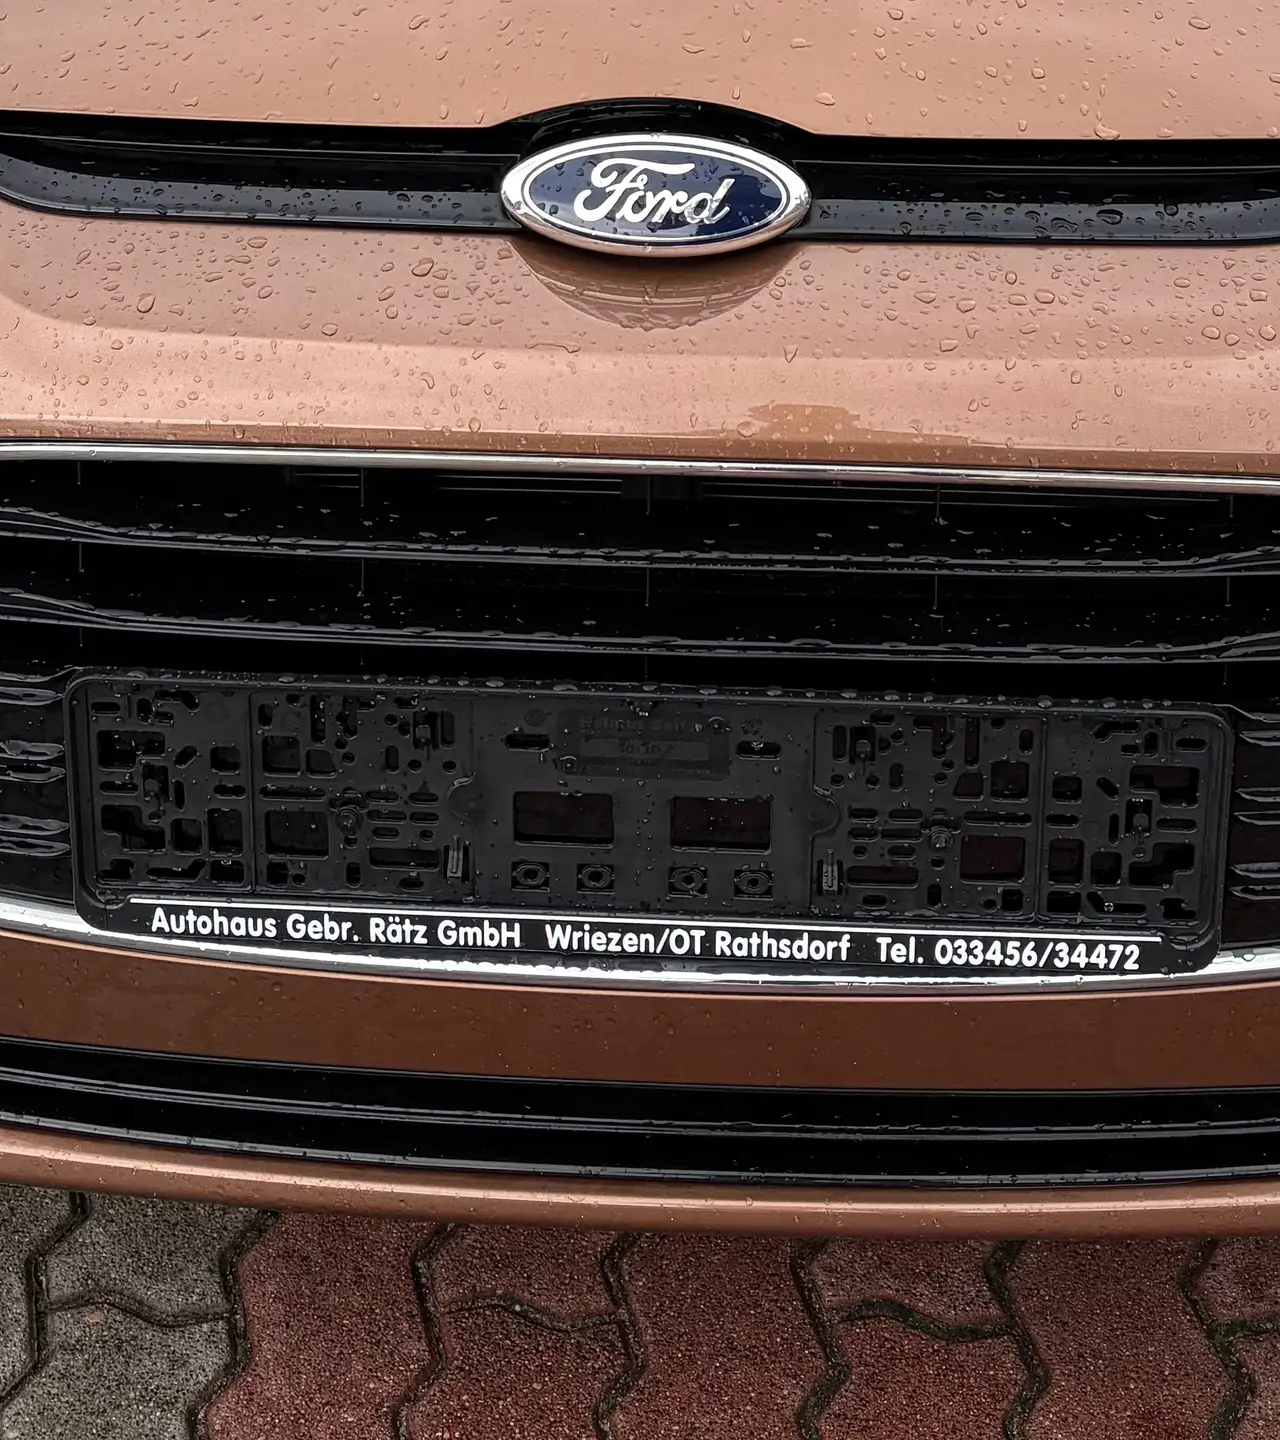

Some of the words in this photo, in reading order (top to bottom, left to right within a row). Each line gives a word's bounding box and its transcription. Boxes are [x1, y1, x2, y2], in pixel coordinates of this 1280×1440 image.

[573, 158, 736, 224] Ford
[151, 907, 277, 938] Autohaus
[286, 913, 360, 942] Gebr.
[369, 917, 428, 945] Rätz
[437, 920, 521, 948] GmbH
[545, 924, 707, 955] Wriezen/OT
[715, 930, 851, 961] Rathsdorf
[876, 936, 924, 964] Tel.
[934, 938, 1140, 970] 033456/34472
